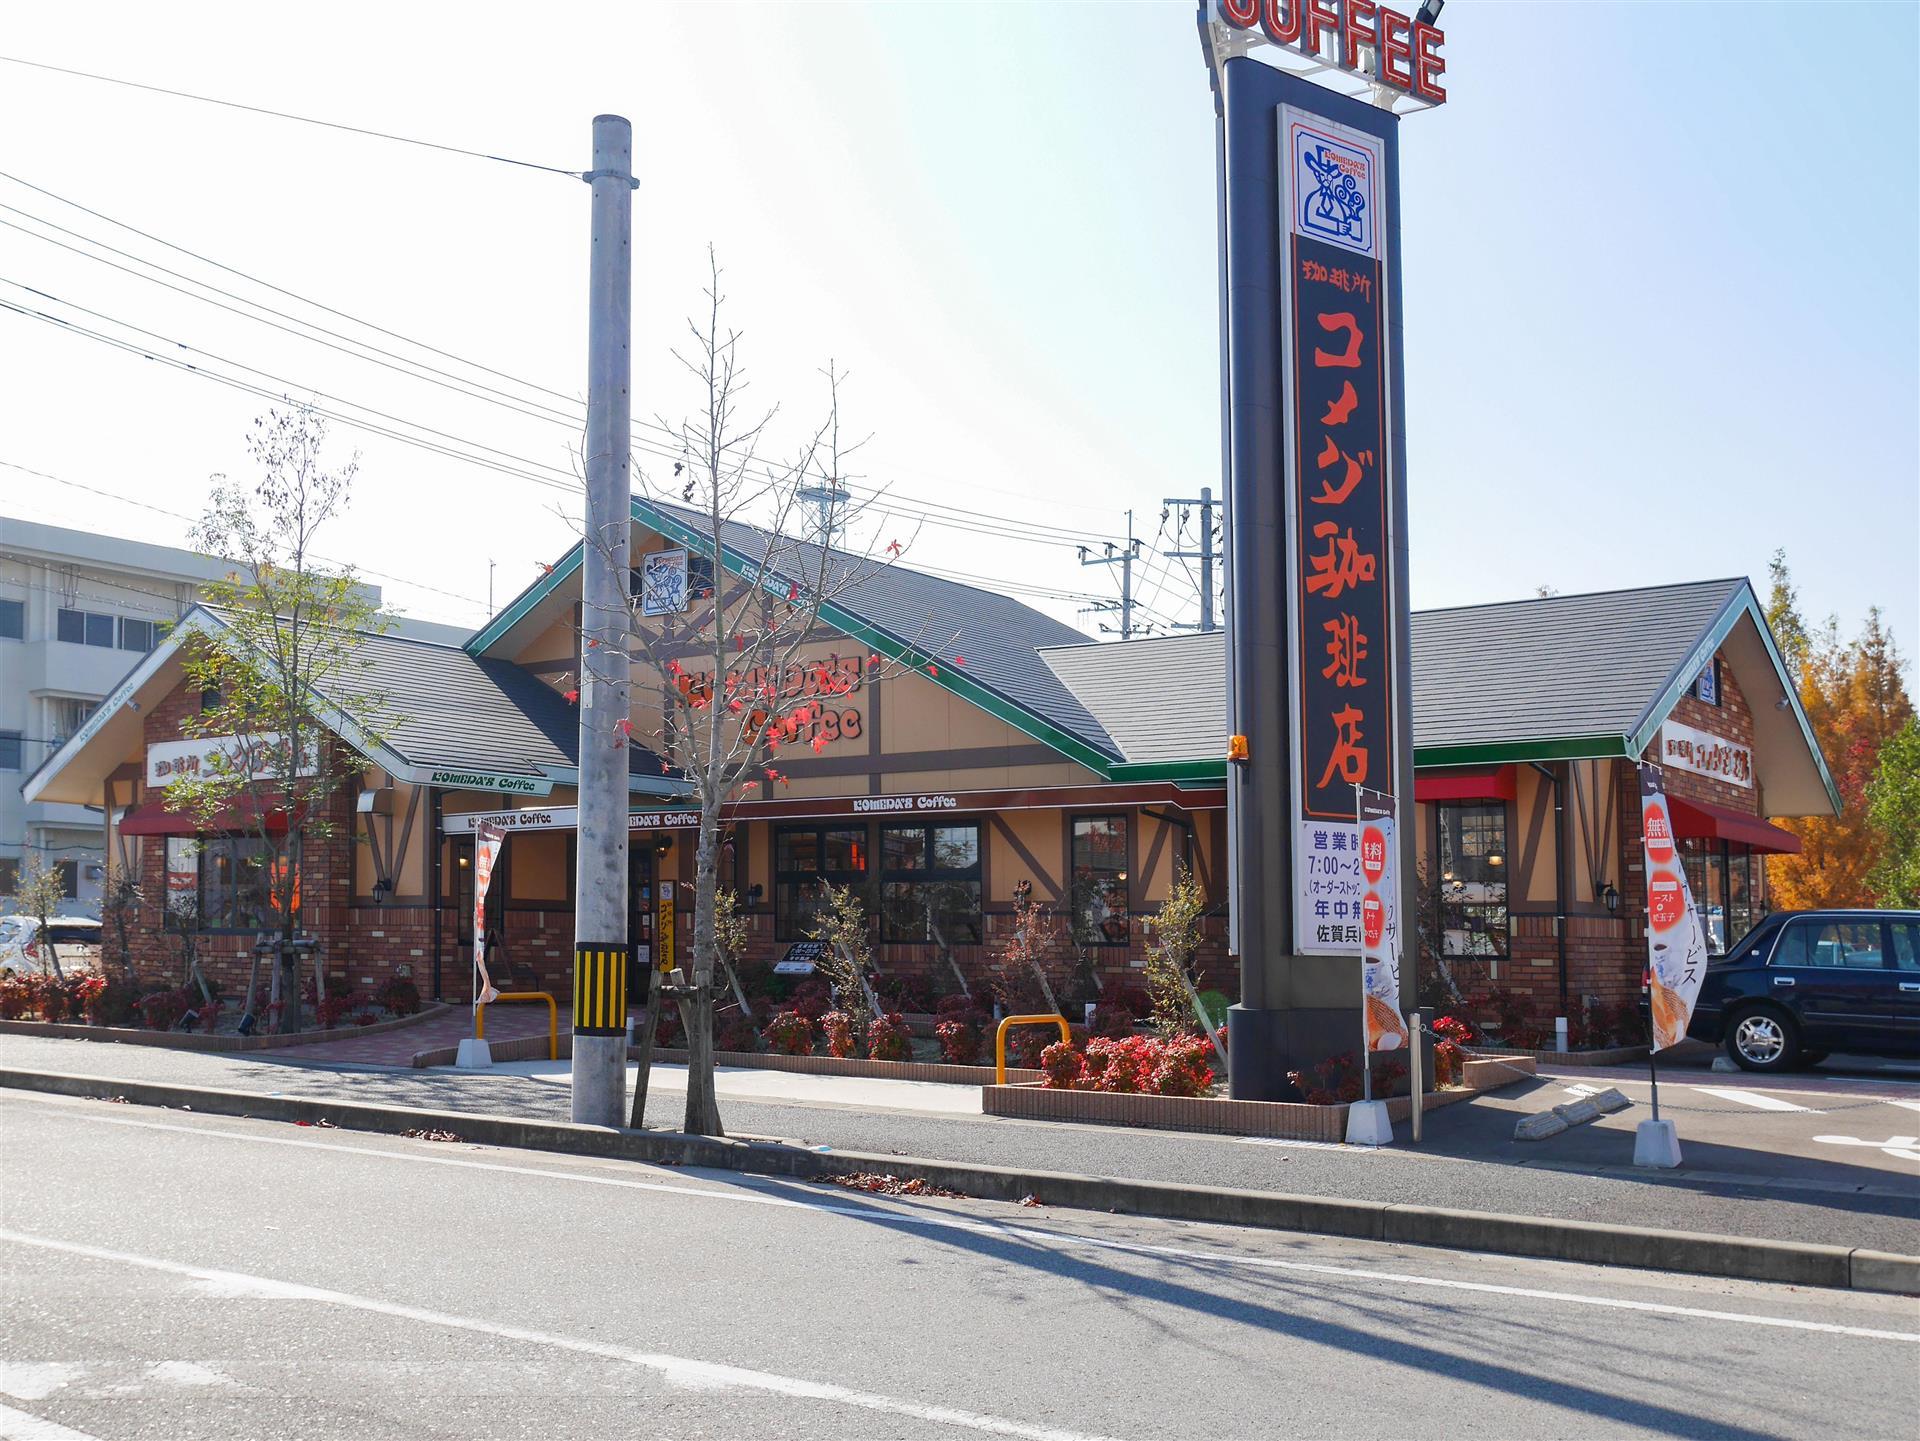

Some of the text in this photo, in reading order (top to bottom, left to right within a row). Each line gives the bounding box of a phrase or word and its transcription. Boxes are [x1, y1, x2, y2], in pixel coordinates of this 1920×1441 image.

[1305, 312, 1376, 789] コメダ珈琲店
[431, 772, 536, 791] KOMEDA'S Coffee
[853, 795, 957, 812] KOMEDA'S Coffee
[520, 813, 552, 825] Coffee
[629, 813, 698, 827] EDA'S Coffee
[1653, 893, 1674, 902] ースト
[1316, 924, 1361, 943] 佐賀兵
